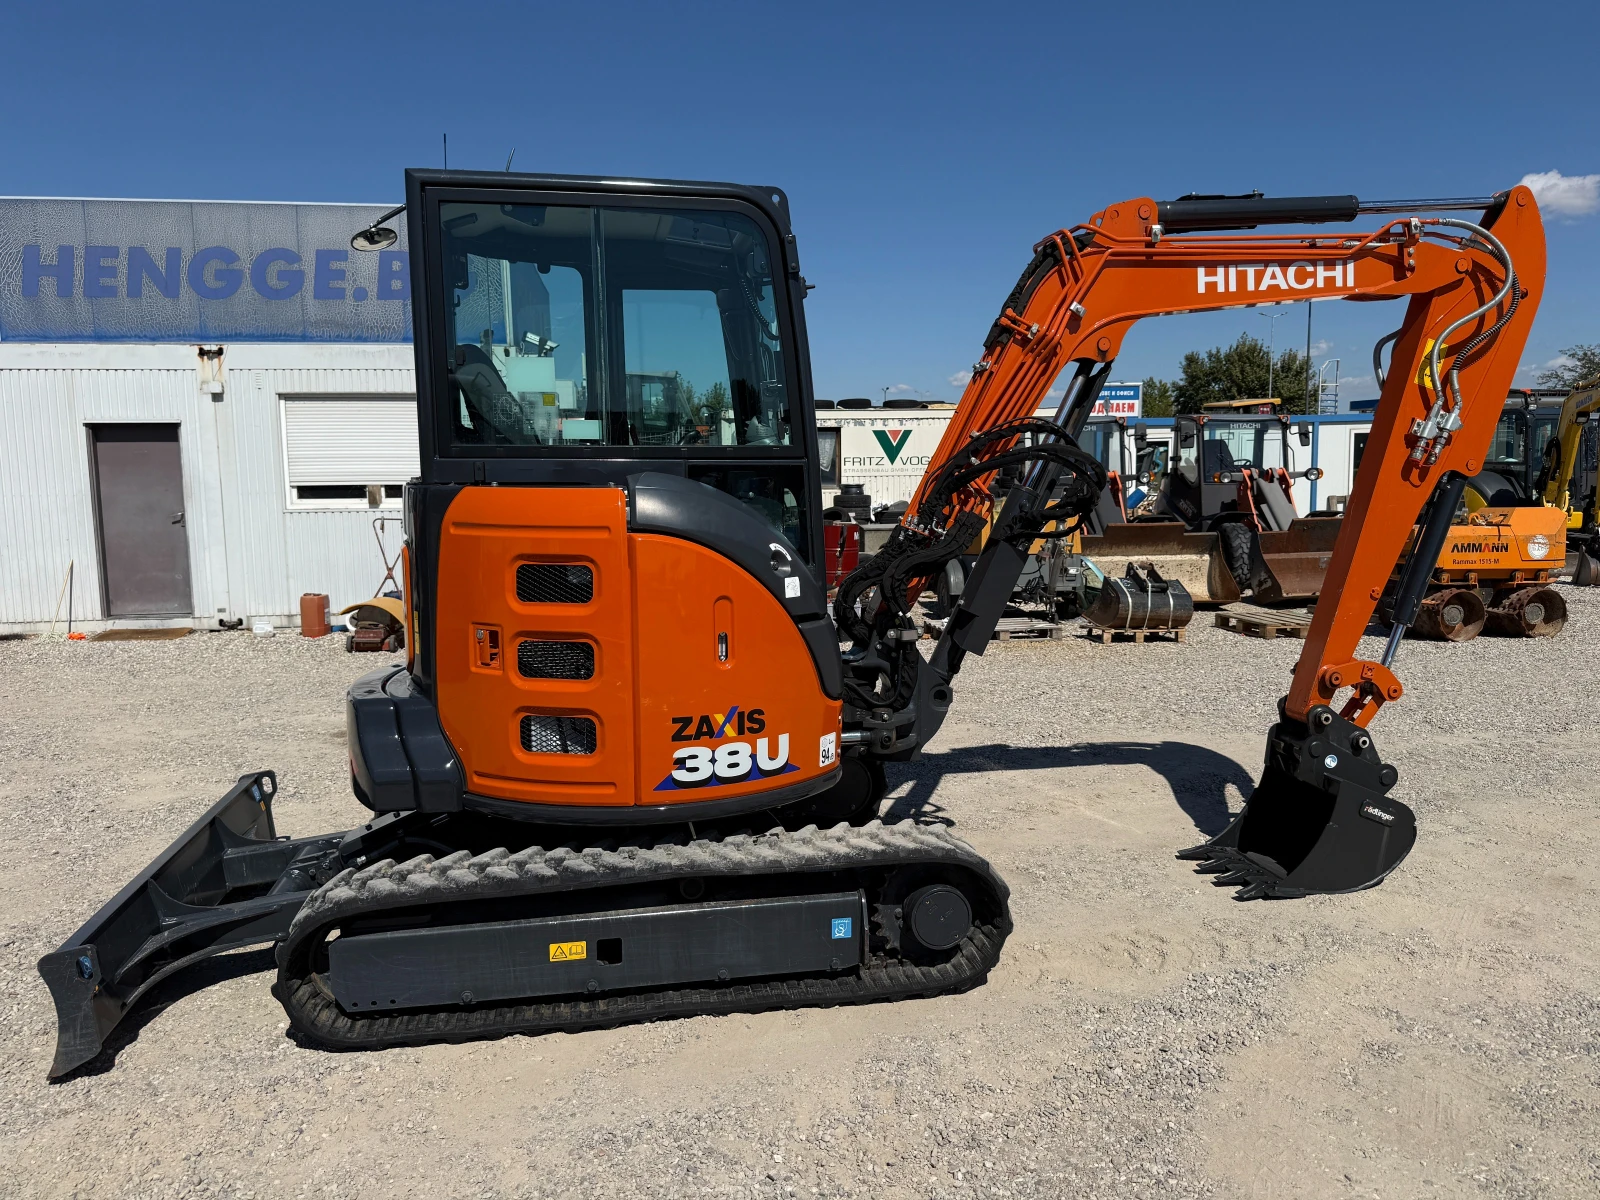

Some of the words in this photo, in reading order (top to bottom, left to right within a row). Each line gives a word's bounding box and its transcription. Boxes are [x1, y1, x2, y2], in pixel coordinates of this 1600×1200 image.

[1197, 260, 1354, 294] HITACHI
[843, 456, 885, 466] FRITZ
[1451, 542, 1509, 553] AMMANN
[671, 705, 766, 742] ZAXIS
[671, 732, 791, 787] 38U
[821, 747, 830, 764] 94
